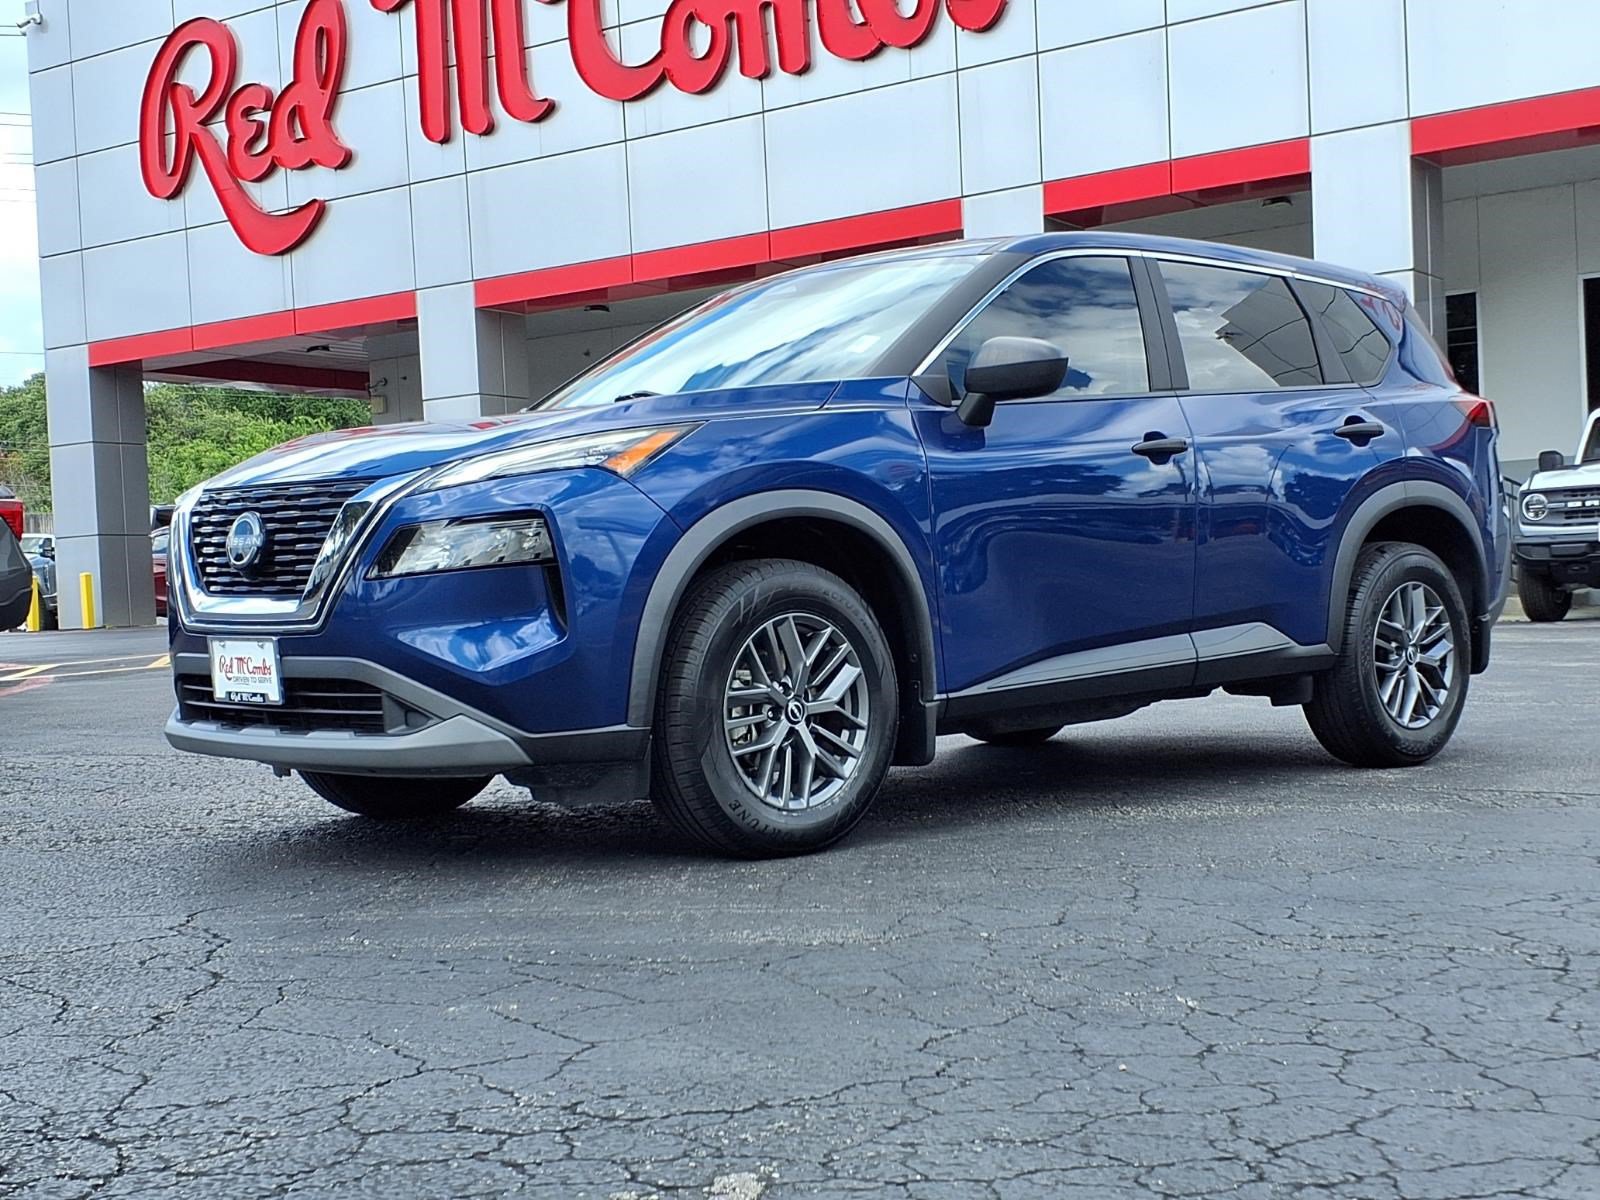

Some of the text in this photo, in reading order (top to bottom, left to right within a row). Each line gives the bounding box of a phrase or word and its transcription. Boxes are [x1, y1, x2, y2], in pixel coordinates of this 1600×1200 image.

[140, 0, 1006, 256] Red MCom
[220, 655, 272, 681] Red McCombs
